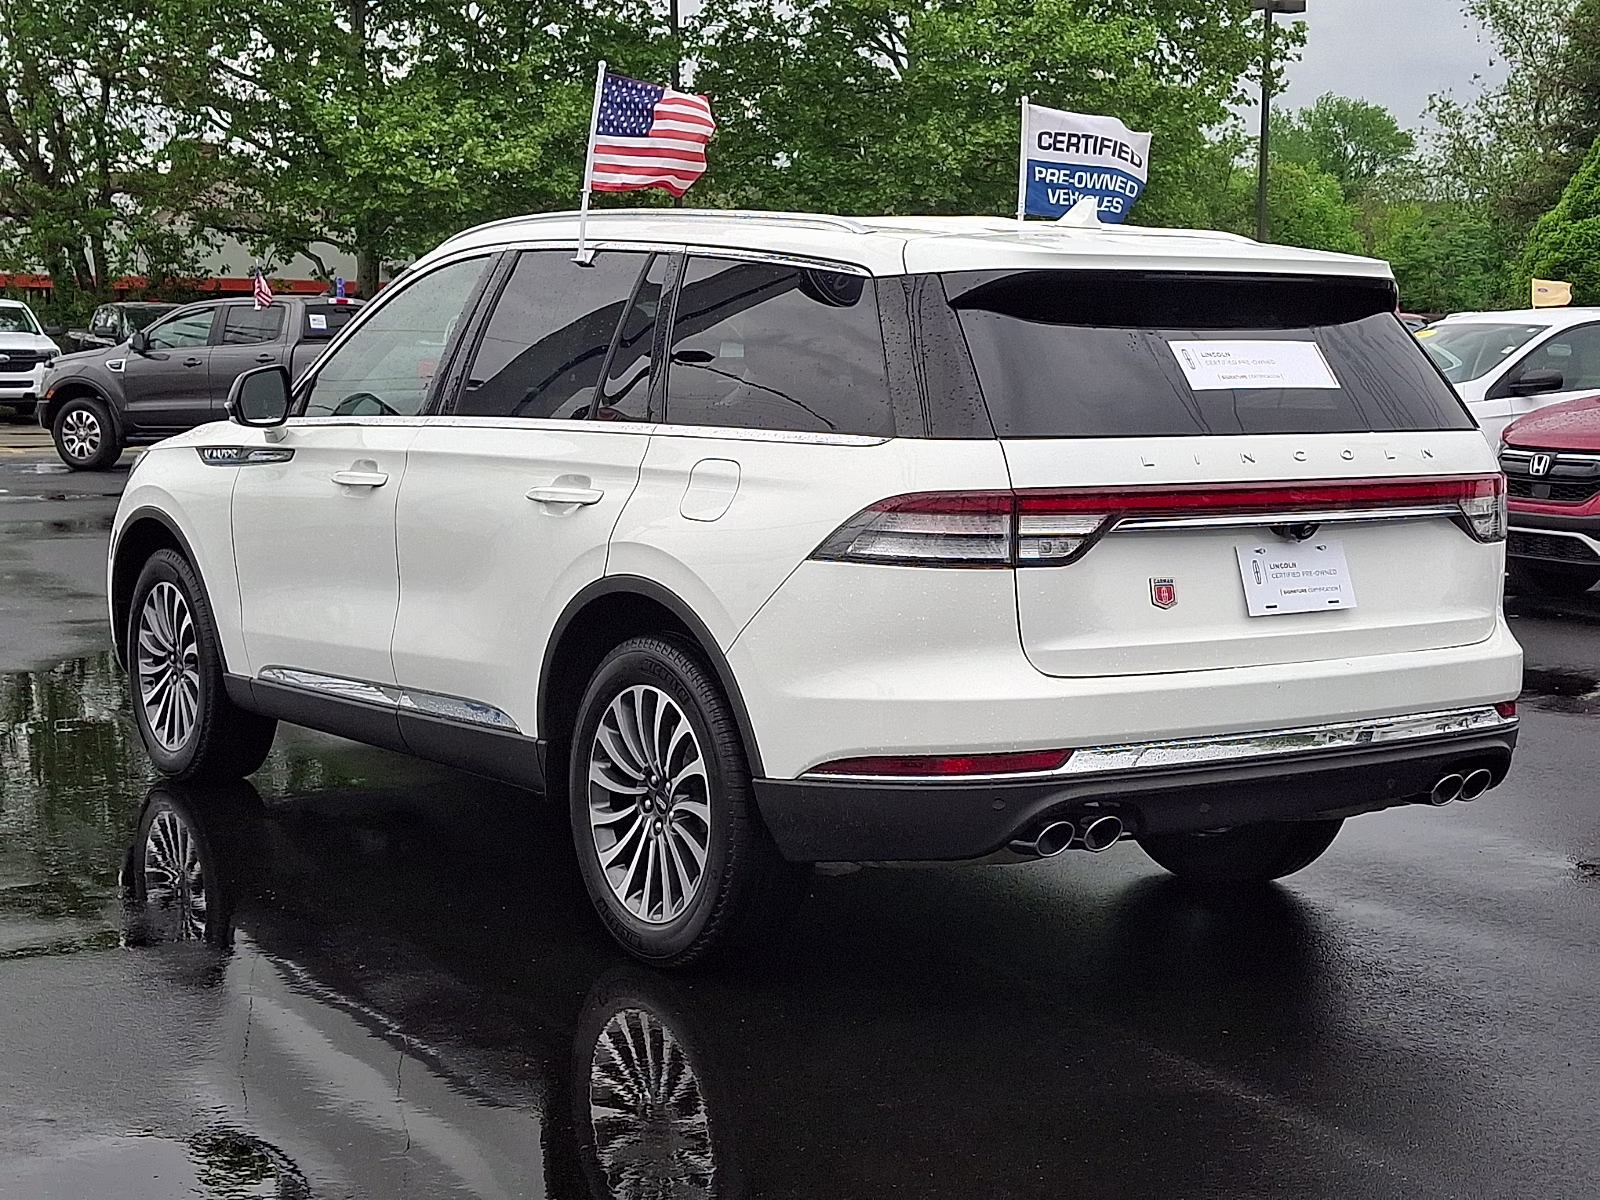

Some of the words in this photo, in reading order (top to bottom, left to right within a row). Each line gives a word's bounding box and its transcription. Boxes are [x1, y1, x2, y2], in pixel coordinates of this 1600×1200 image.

[1037, 131, 1143, 169] CERTIFIED
[1034, 166, 1139, 198] PRE-OWNED
[1047, 188, 1124, 214] VEHLES
[1140, 448, 1435, 467] LINCOLN
[1269, 562, 1297, 570] LINCOLN
